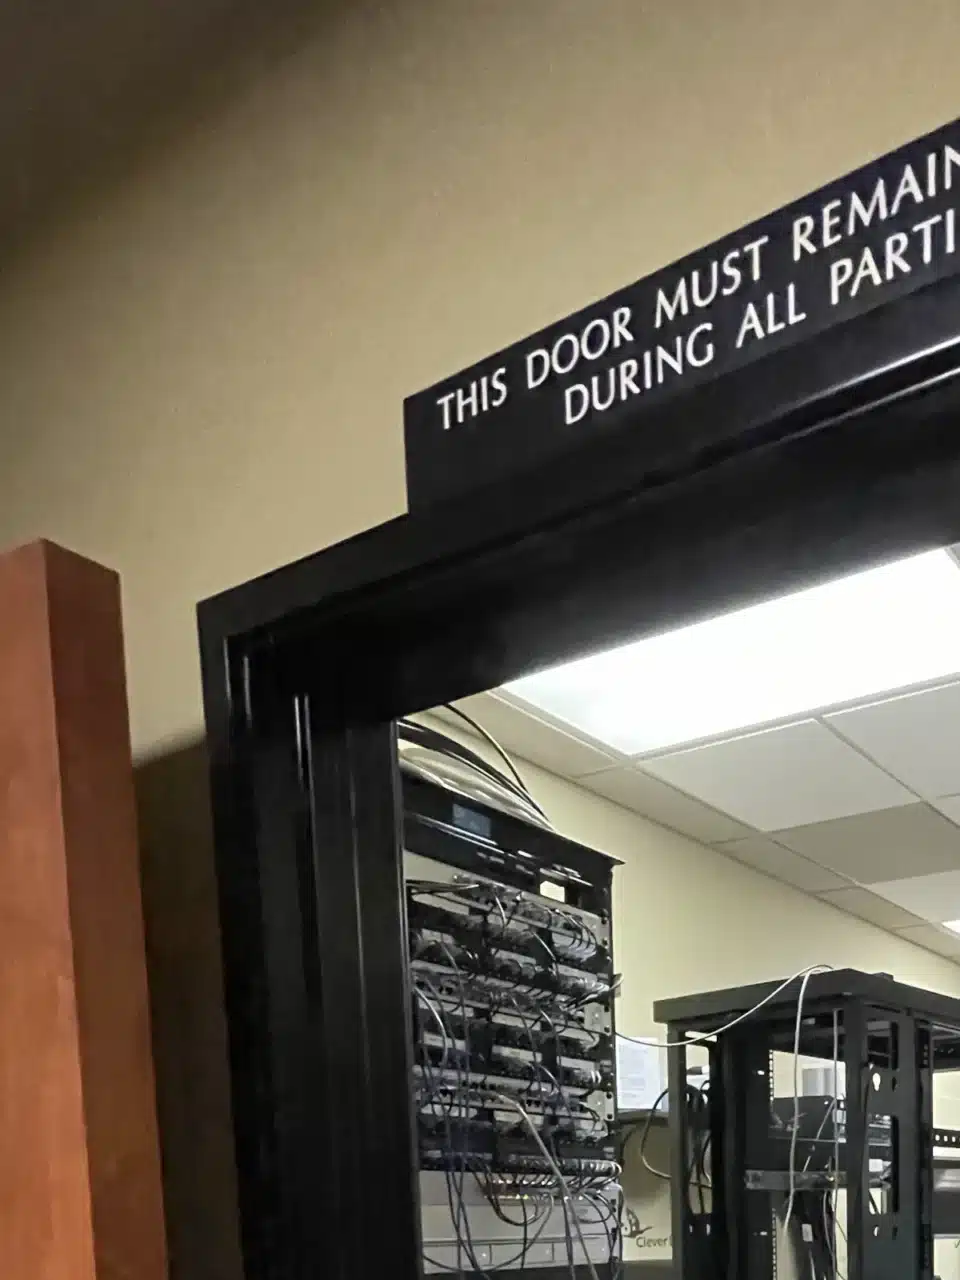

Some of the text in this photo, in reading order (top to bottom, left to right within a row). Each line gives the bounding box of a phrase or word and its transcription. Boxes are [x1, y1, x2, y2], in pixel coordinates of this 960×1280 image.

[436, 367, 507, 430] THIS
[526, 306, 634, 390] DOOR
[654, 235, 769, 329] MUST
[564, 322, 714, 425] DURING
[735, 281, 807, 349] ALL
